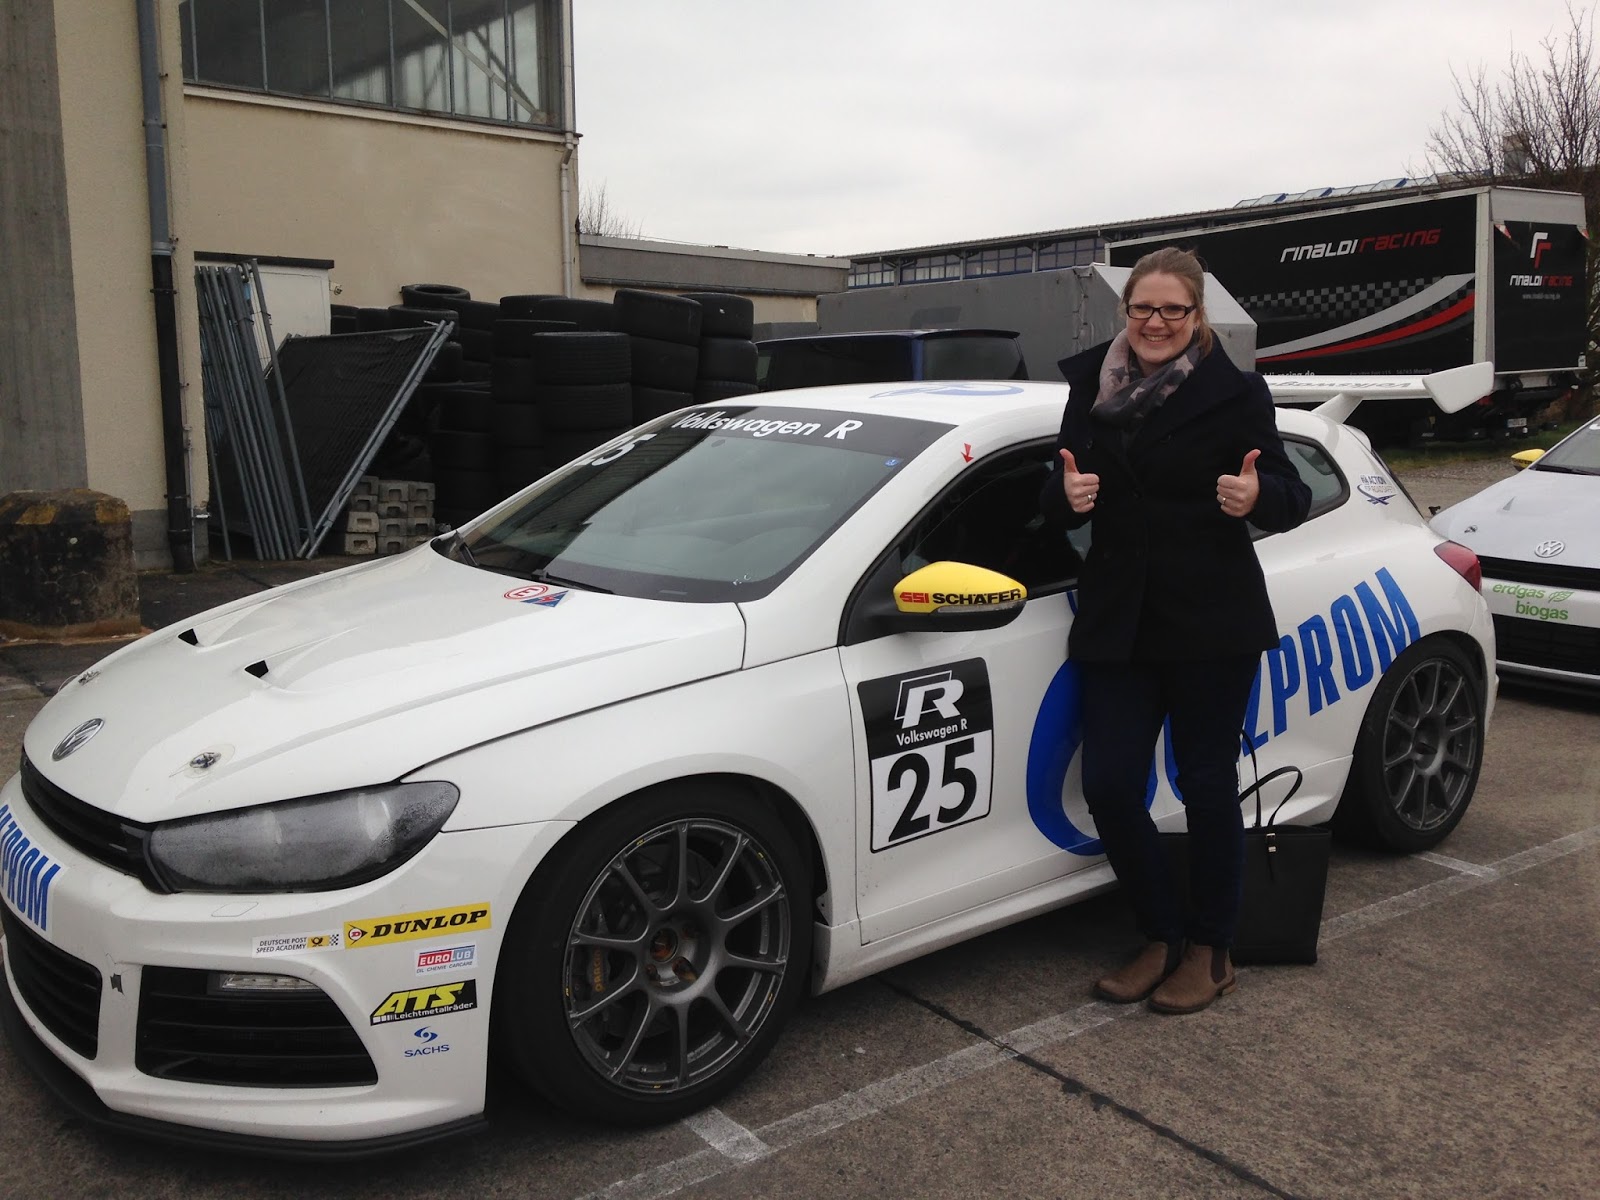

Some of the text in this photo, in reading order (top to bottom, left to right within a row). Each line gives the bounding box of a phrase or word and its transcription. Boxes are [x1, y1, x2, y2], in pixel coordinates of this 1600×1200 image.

[672, 411, 863, 440] Volkswagen R
[900, 588, 1022, 605] SSI SCHÄFER
[1492, 584, 1546, 599] erdgas
[1515, 600, 1569, 620] biogas
[1240, 566, 1421, 758] ZPROM
[897, 674, 964, 729] R
[896, 718, 968, 746] Volkswagen R
[887, 737, 977, 843] 25
[0, 804, 61, 932] ZPROM
[371, 909, 488, 939] DUNLOP
[259, 938, 291, 947] DEUTSCHE
[275, 943, 307, 952] ACADEMY
[419, 949, 472, 966] EUROLUB
[374, 982, 465, 1016] ATS
[394, 1002, 474, 1021] Leichtmetallräder
[404, 1044, 450, 1058] SACHS
